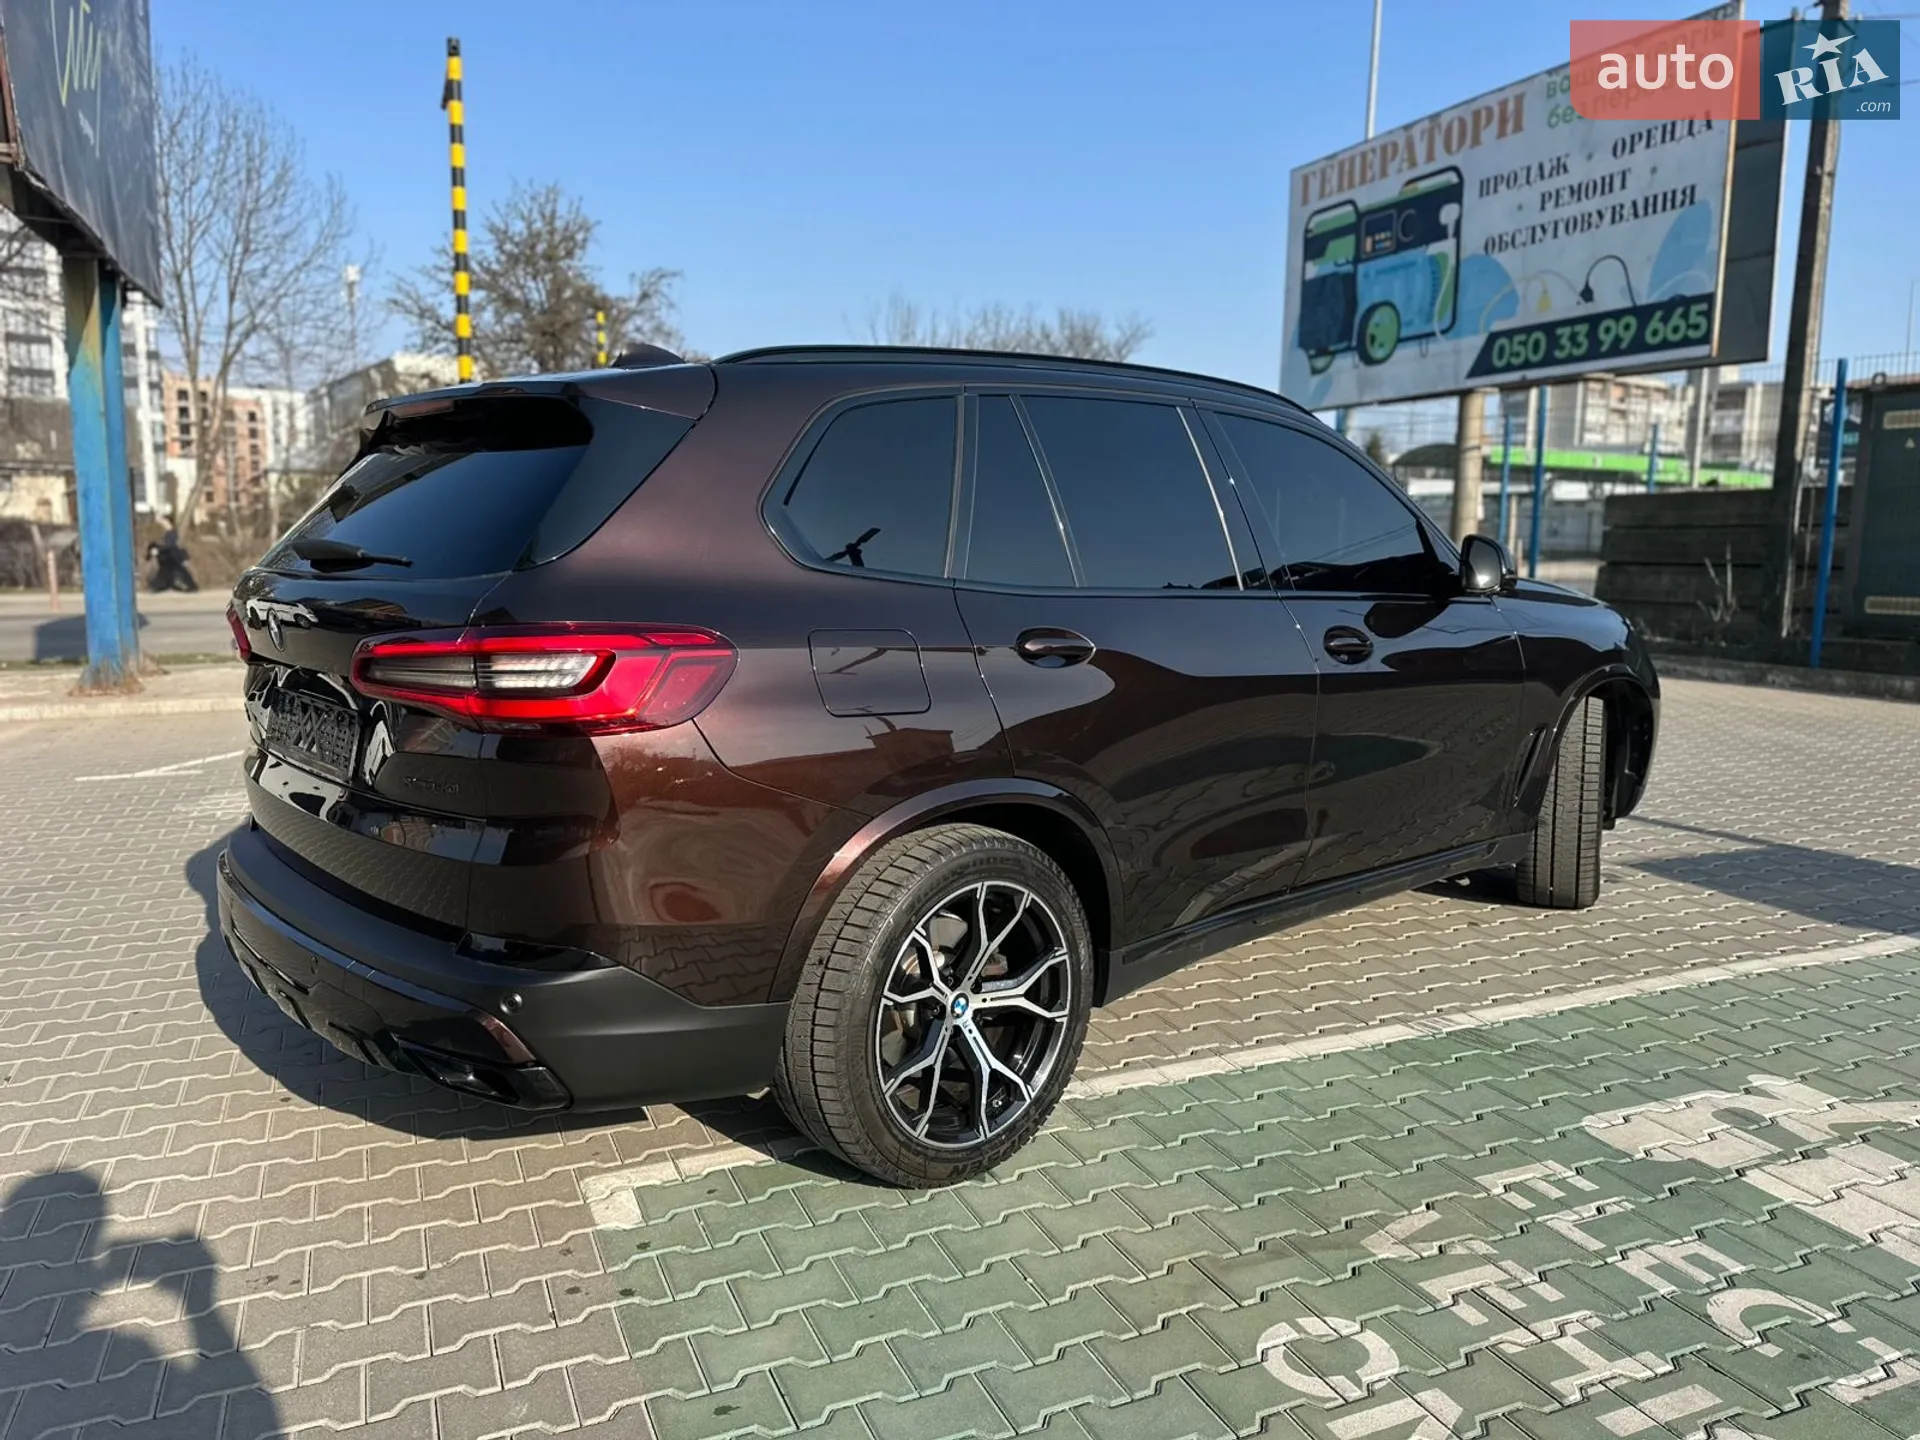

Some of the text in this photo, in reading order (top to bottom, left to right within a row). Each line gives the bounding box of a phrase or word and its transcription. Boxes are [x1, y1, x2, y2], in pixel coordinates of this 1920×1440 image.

[1300, 92, 1526, 207] ГЕНЕРАТОРИ
[1478, 110, 1714, 198] ПРОДАЖ ОРЕНДА
[1483, 183, 1698, 257] ОБСЛУГОВУВАННЯ
[1539, 167, 1632, 213] РЕМОНТ
[1491, 302, 1709, 368] 050 33 99 665
